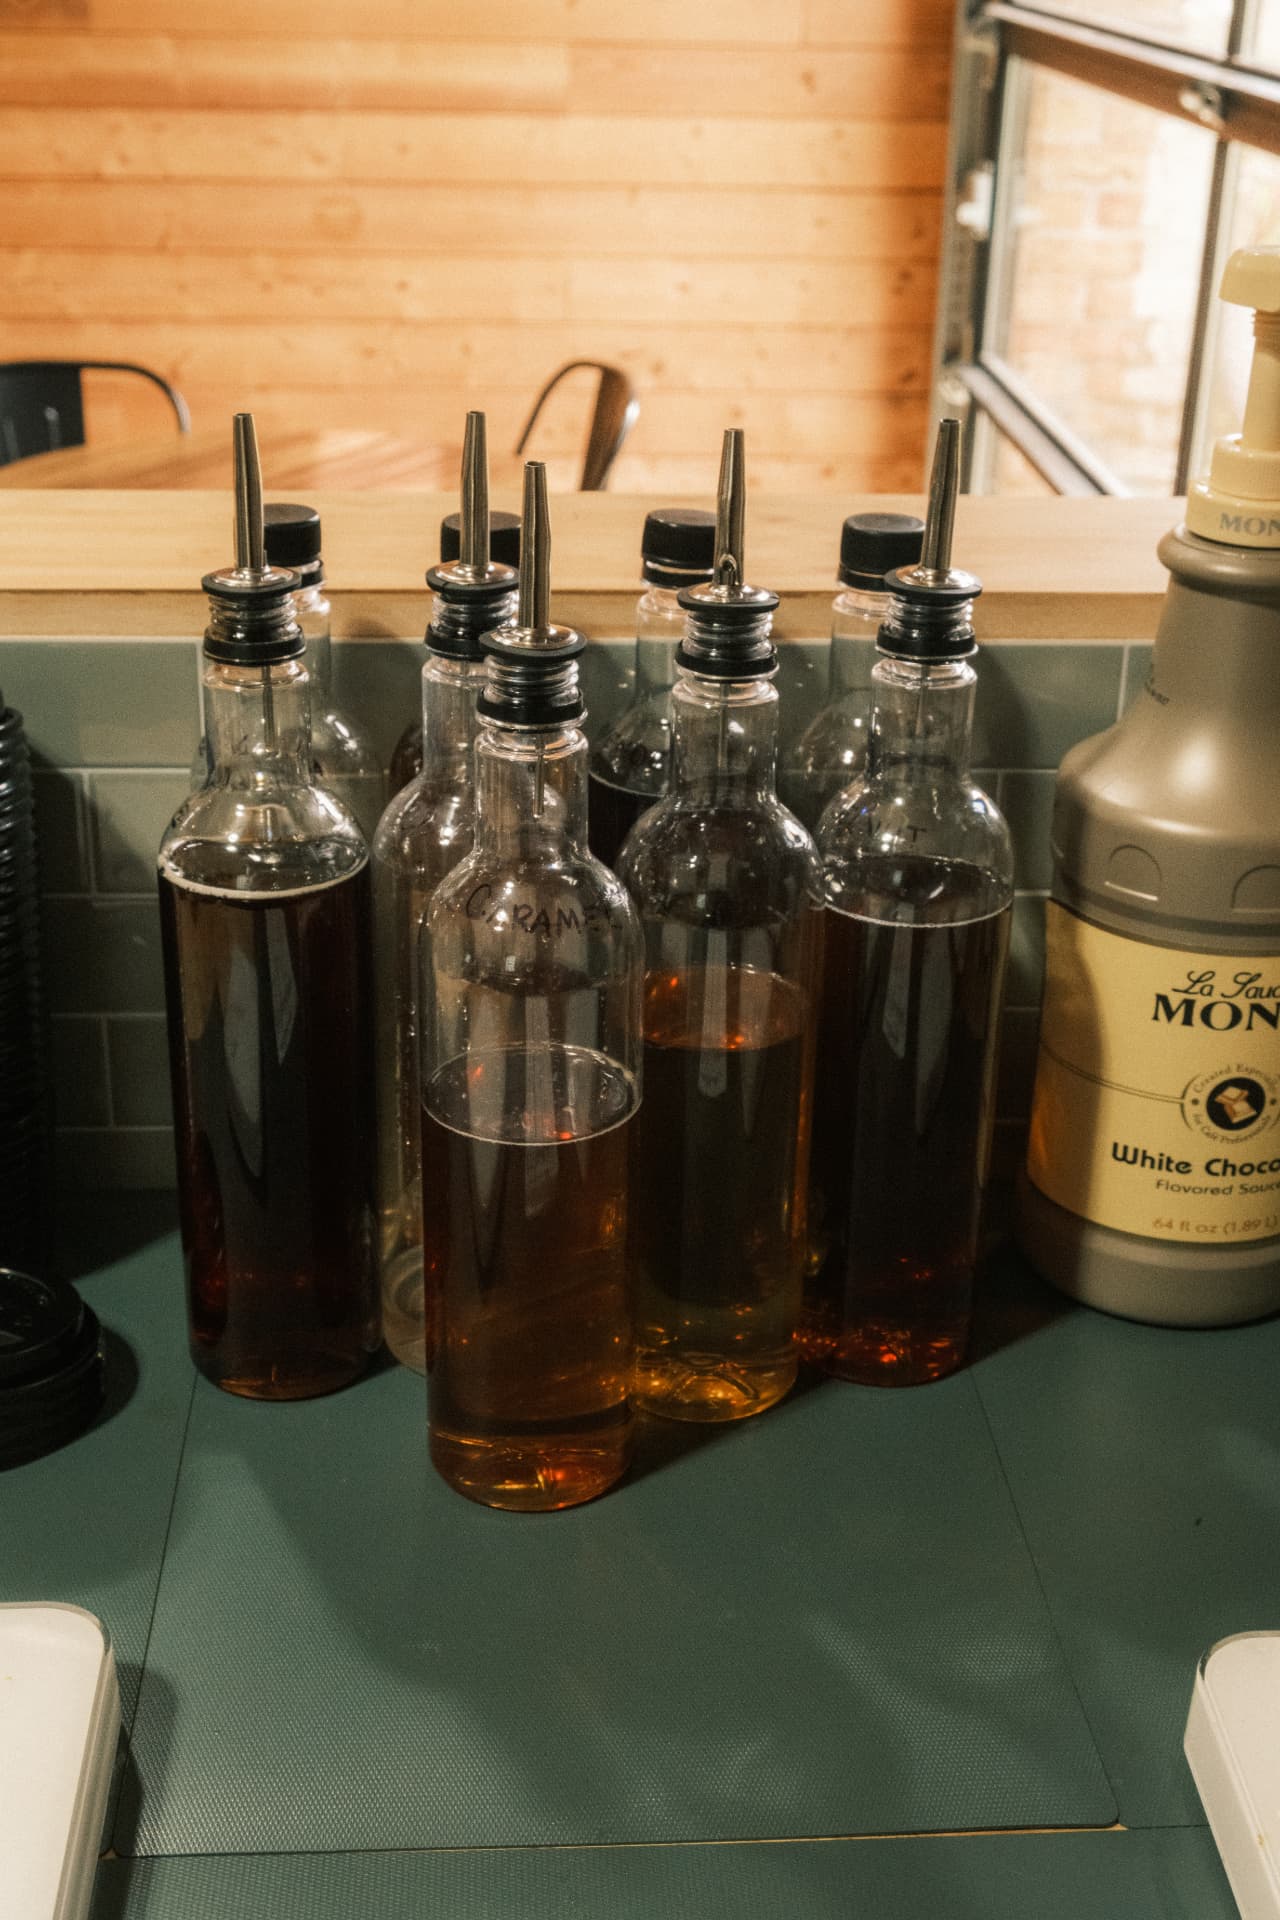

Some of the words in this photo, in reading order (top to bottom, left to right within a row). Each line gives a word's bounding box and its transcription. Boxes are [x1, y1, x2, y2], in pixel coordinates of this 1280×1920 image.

[1172, 970, 1216, 997] La
[1152, 993, 1280, 1031] MON
[1112, 1142, 1193, 1175] White
[1156, 1179, 1234, 1195] Flavored
[1152, 1217, 1174, 1230] 64
[1196, 1223, 1218, 1233] oz
